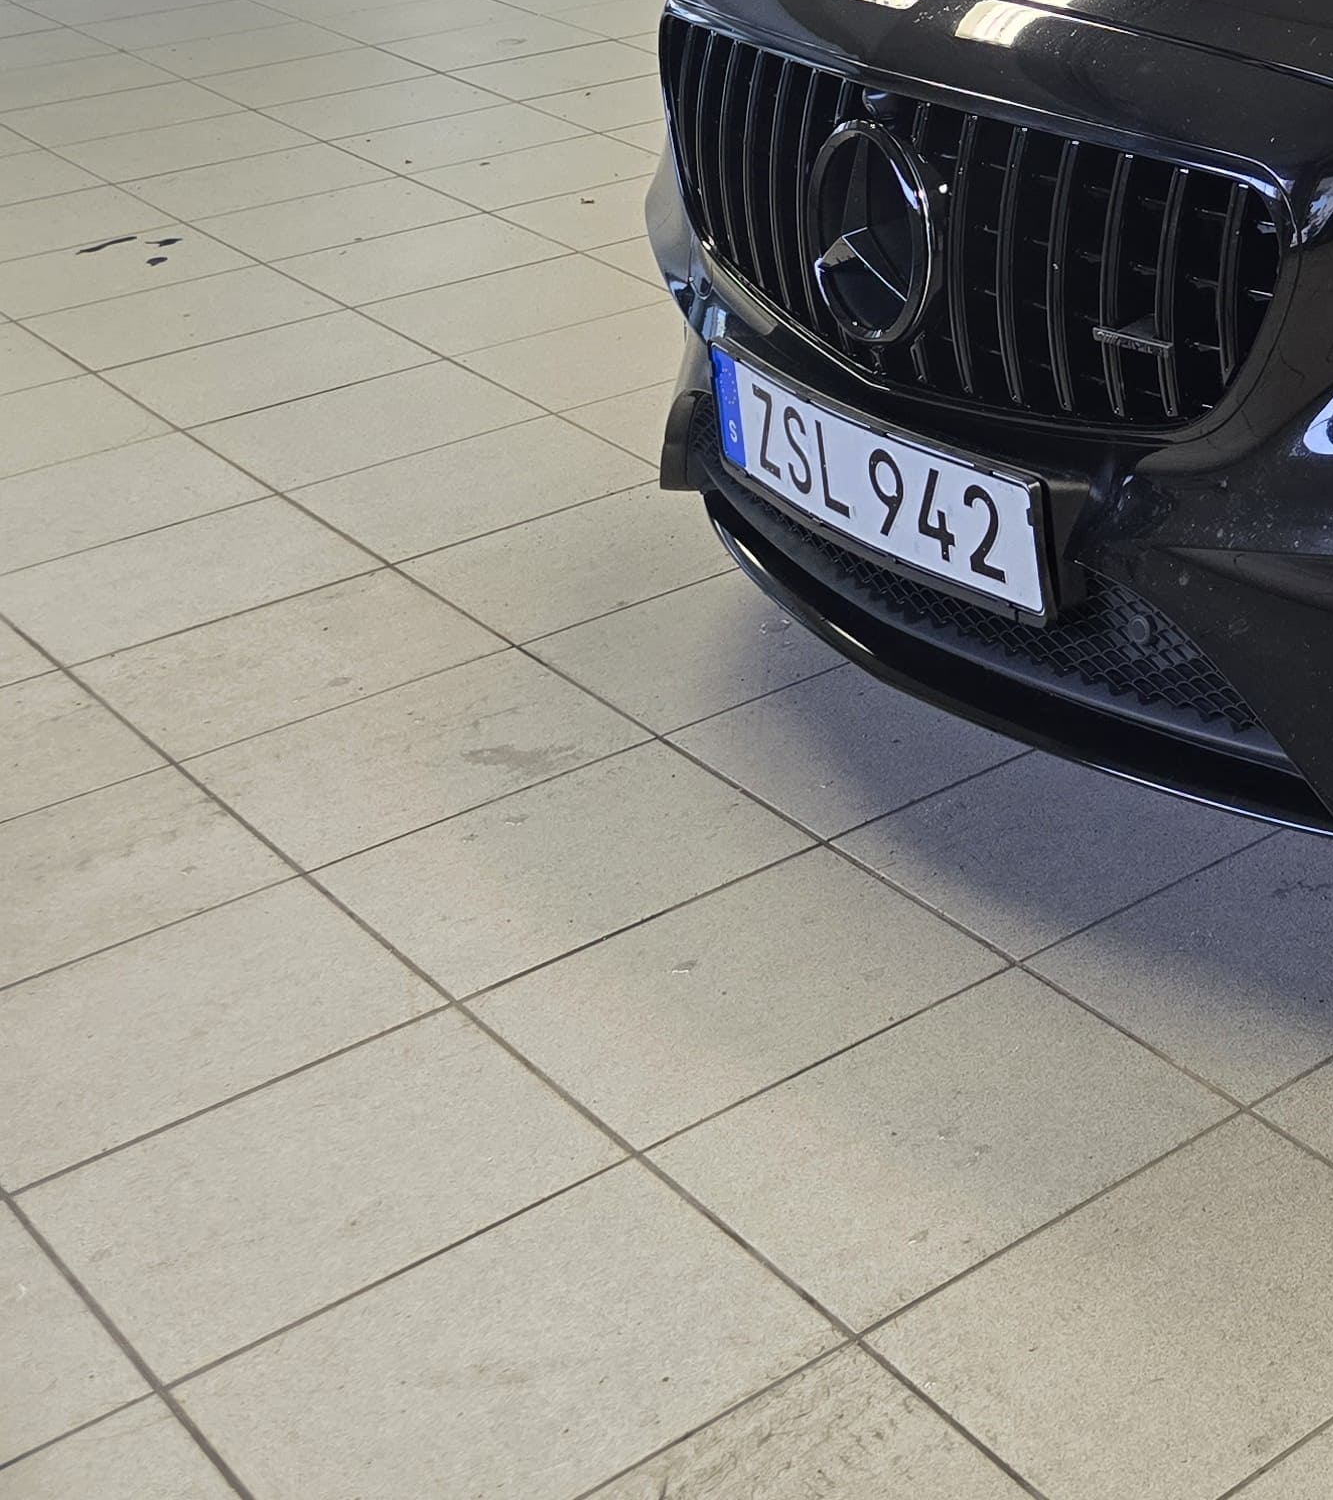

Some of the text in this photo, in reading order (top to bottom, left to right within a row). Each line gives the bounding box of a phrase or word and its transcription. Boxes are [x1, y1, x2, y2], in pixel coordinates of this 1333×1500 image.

[729, 420, 738, 443] S
[752, 383, 1007, 584] ZSL 942
